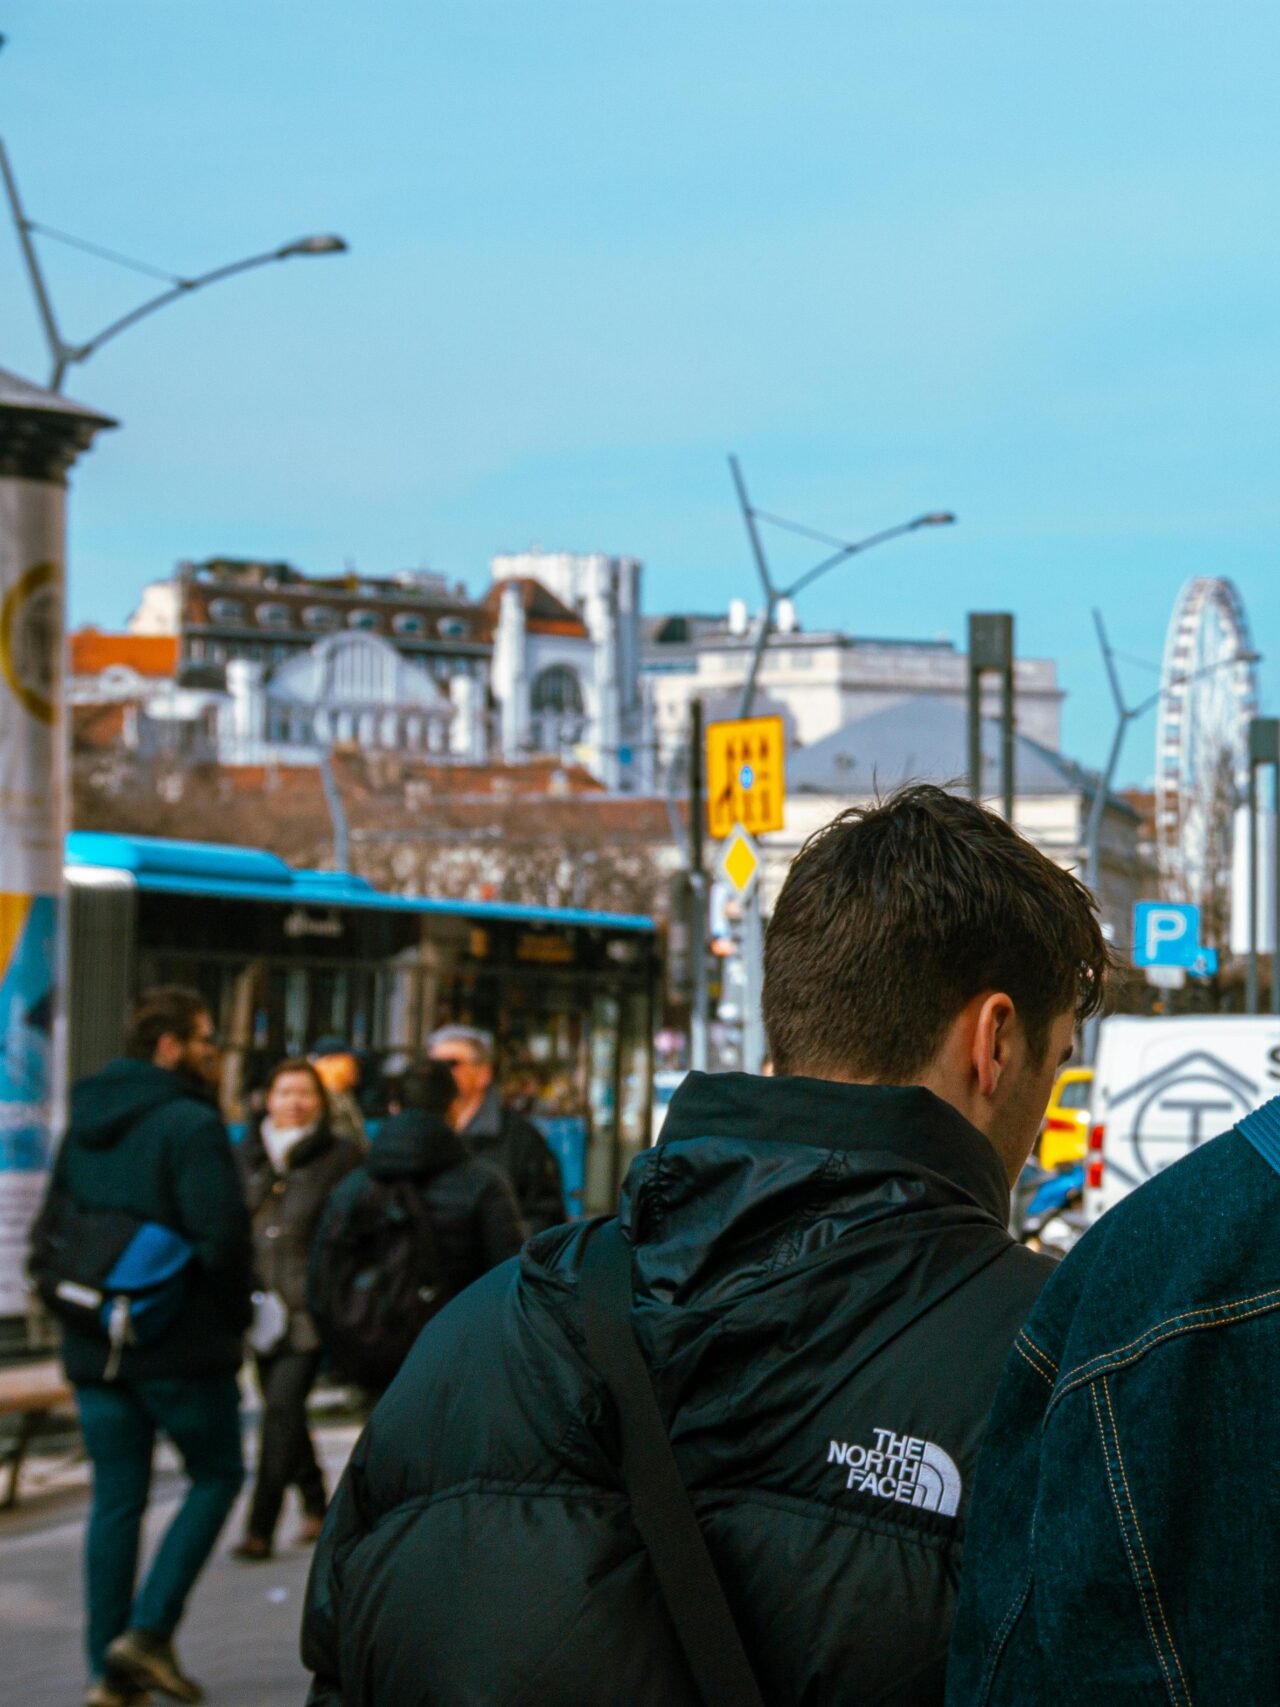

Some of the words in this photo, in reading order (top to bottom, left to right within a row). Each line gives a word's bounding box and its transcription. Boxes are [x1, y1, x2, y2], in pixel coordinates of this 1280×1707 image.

[1146, 909, 1187, 959] P
[827, 1440, 920, 1483] NORTH
[873, 1428, 925, 1461] THE
[846, 1468, 915, 1505] FACE
